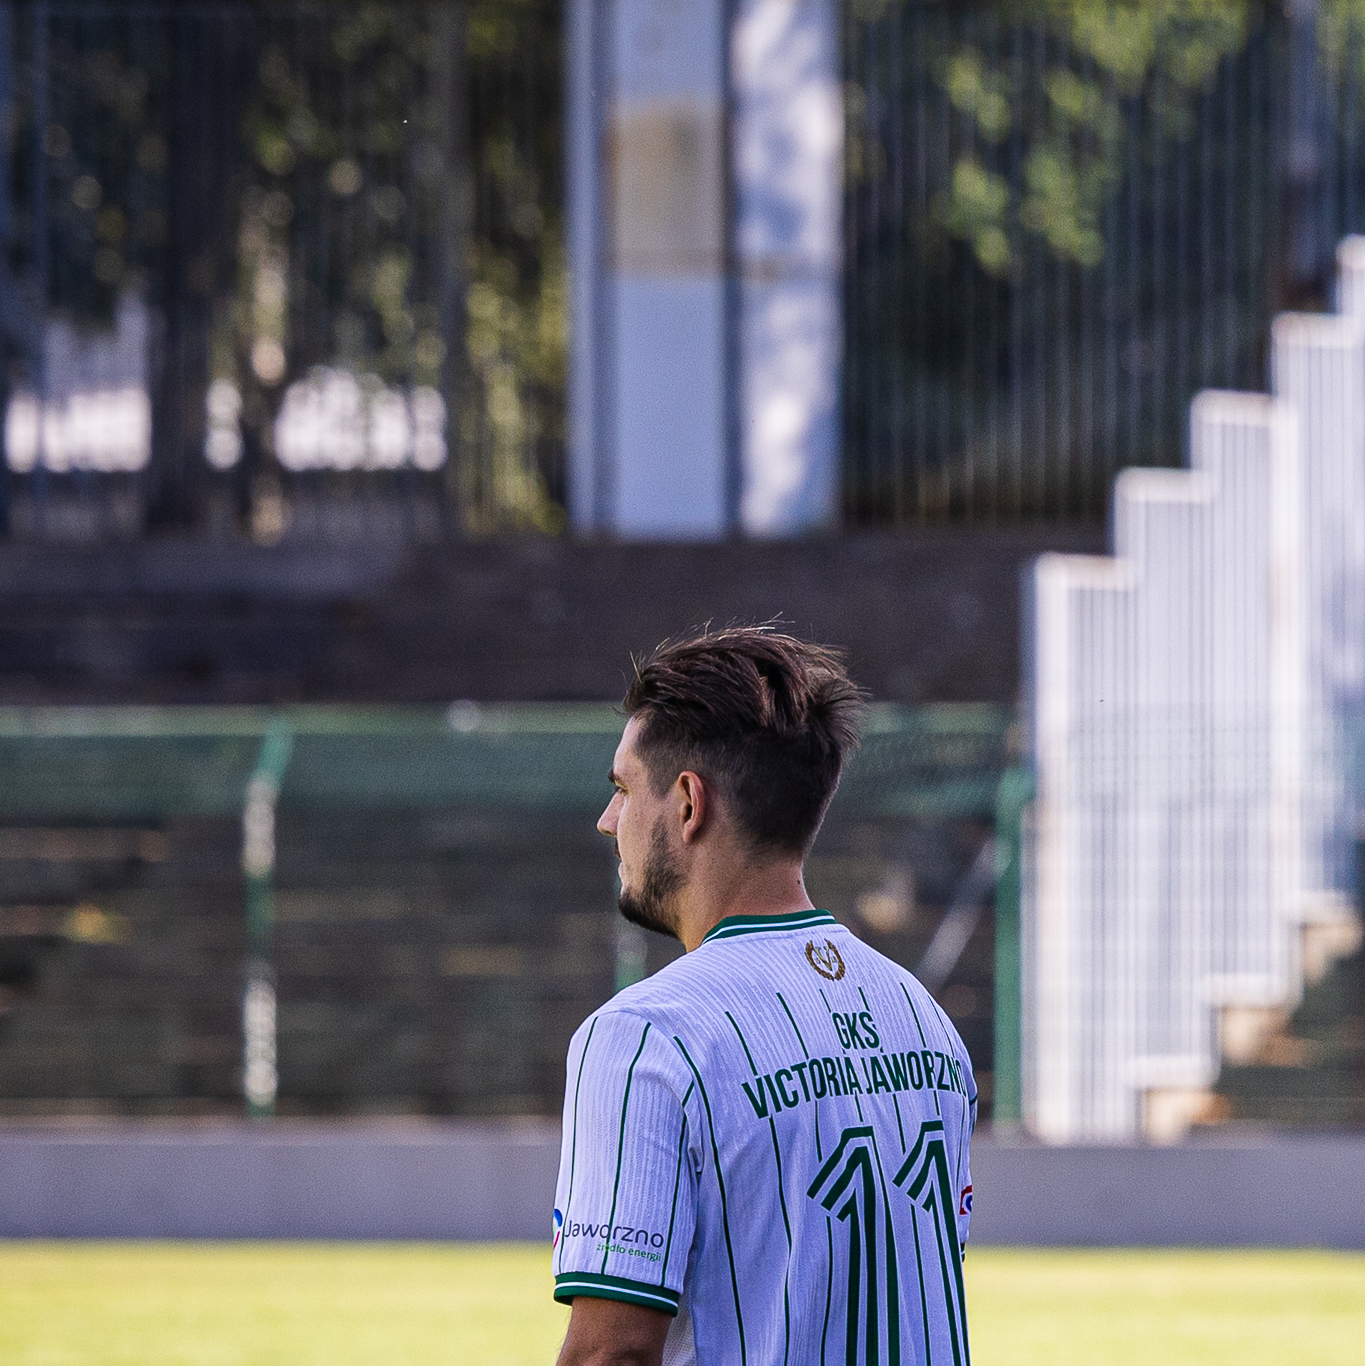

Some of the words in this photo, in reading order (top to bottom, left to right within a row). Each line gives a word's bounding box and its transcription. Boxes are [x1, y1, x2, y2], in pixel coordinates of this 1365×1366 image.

[831, 1011, 880, 1050] GKS
[741, 1055, 863, 1120] VICTORIA
[860, 1050, 967, 1098] JAWORZNO
[564, 1220, 664, 1248] Jaworzno
[627, 1248, 662, 1262] energii
